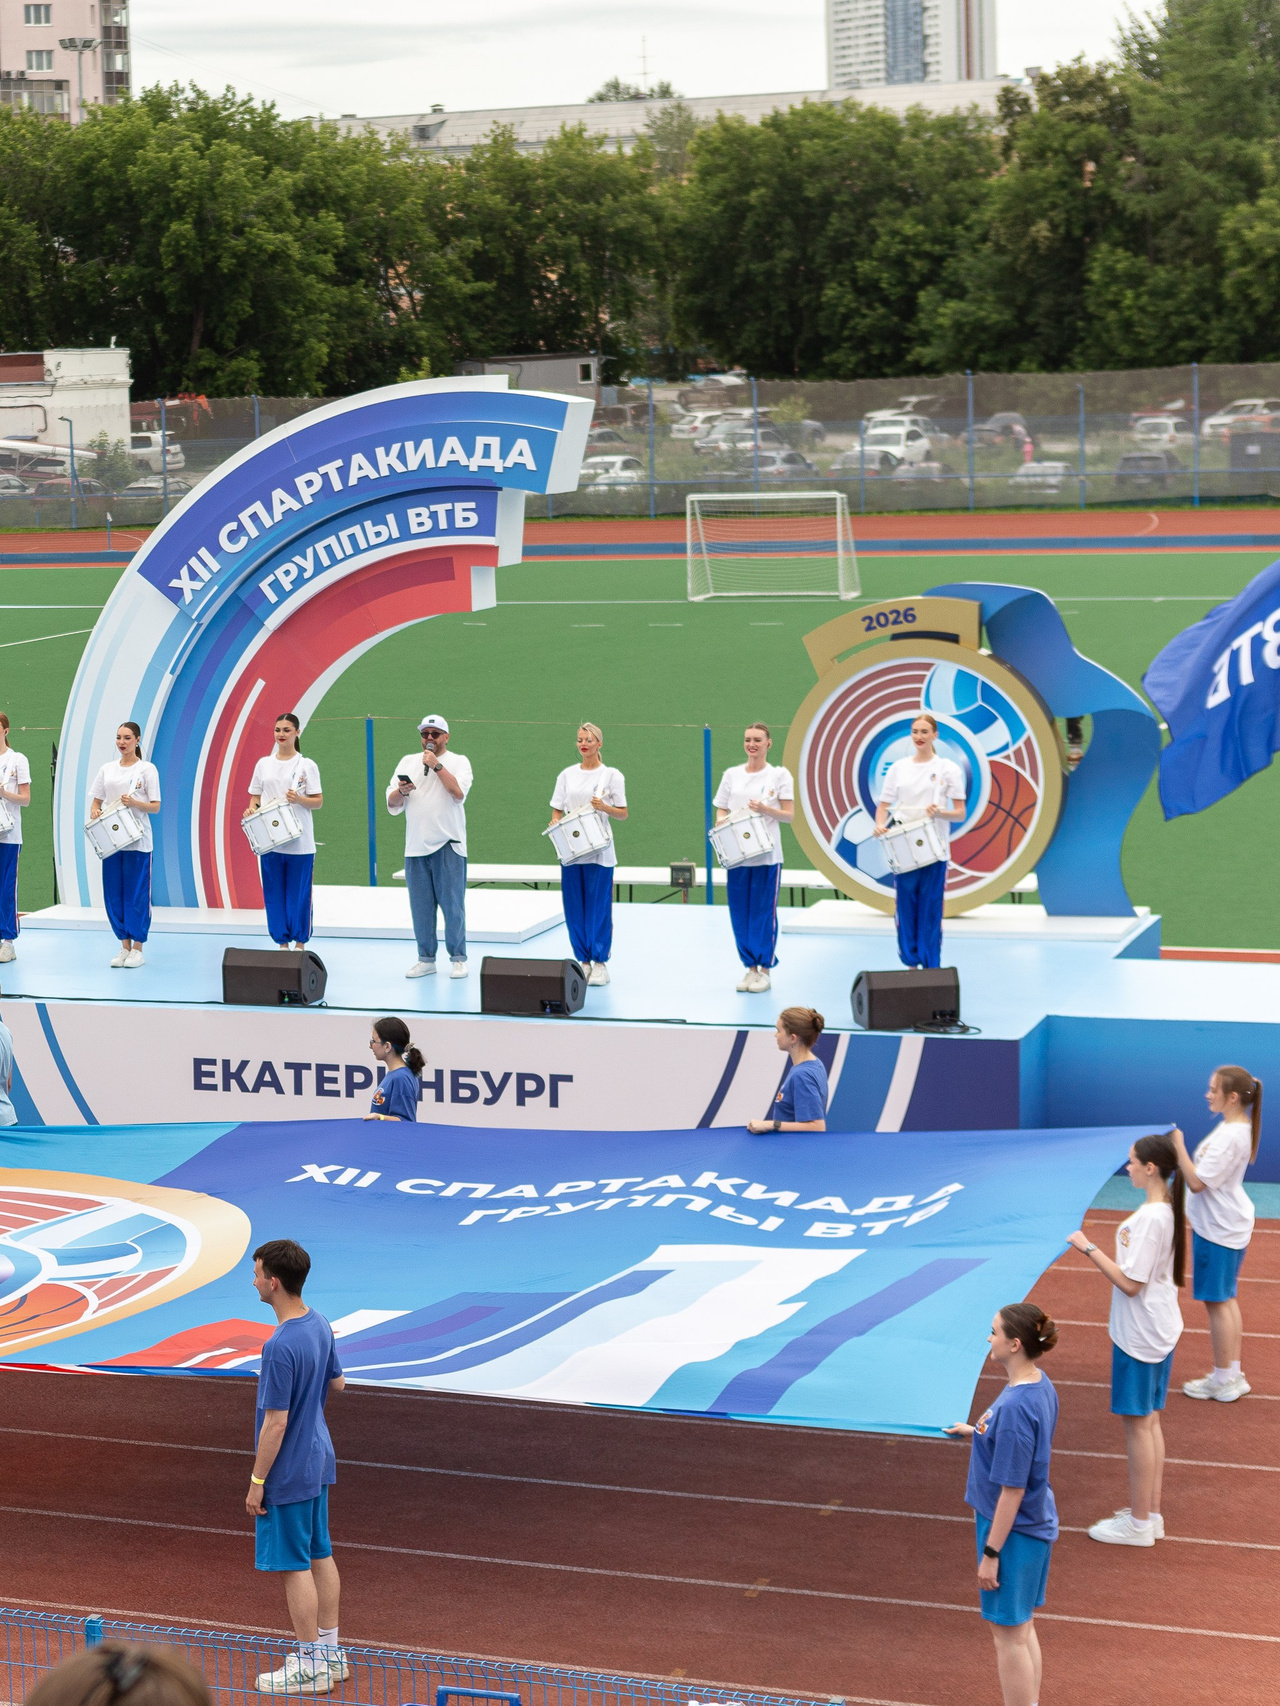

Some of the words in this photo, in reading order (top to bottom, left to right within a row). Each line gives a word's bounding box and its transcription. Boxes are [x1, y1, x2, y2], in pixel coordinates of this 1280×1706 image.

[218, 436, 537, 554] СПАРТАКИАДА
[258, 513, 400, 604] ГРУППЫ
[406, 502, 479, 535] ВТБ
[861, 606, 917, 632] 2026
[394, 1171, 965, 1216] СПАРТАКИАДА
[457, 1194, 784, 1232] ГРУППЫ
[802, 1198, 952, 1239] ВТБ
